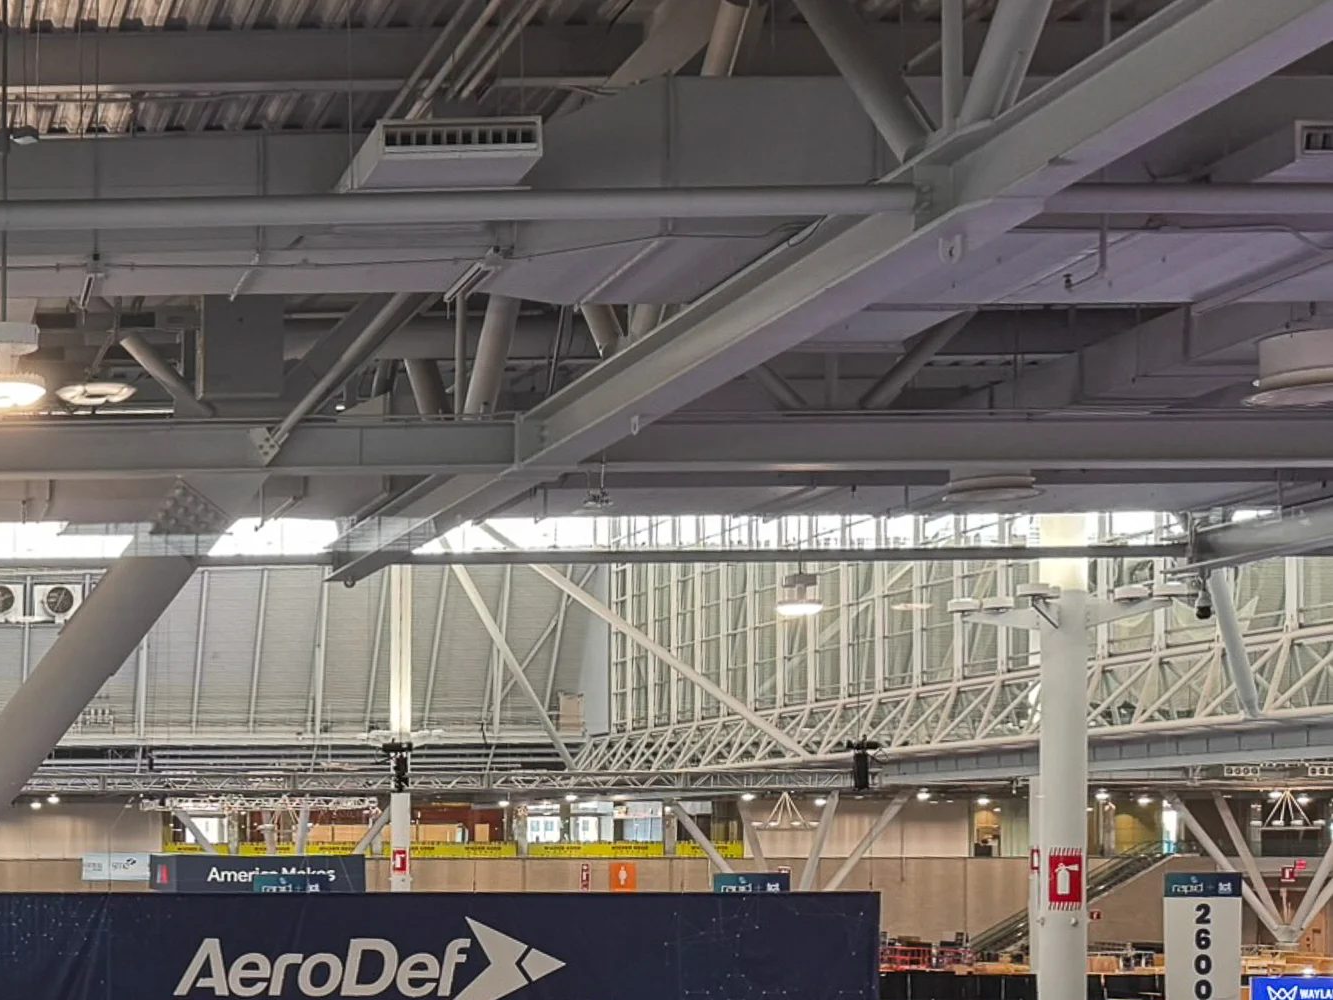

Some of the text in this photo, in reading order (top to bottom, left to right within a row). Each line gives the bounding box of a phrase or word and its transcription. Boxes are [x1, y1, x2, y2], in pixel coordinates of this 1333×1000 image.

[1172, 881, 1204, 894] rapid
[173, 937, 472, 998] AeroDef
[1194, 903, 1212, 1000] 2600
[1299, 988, 1333, 1000] WAYLA
